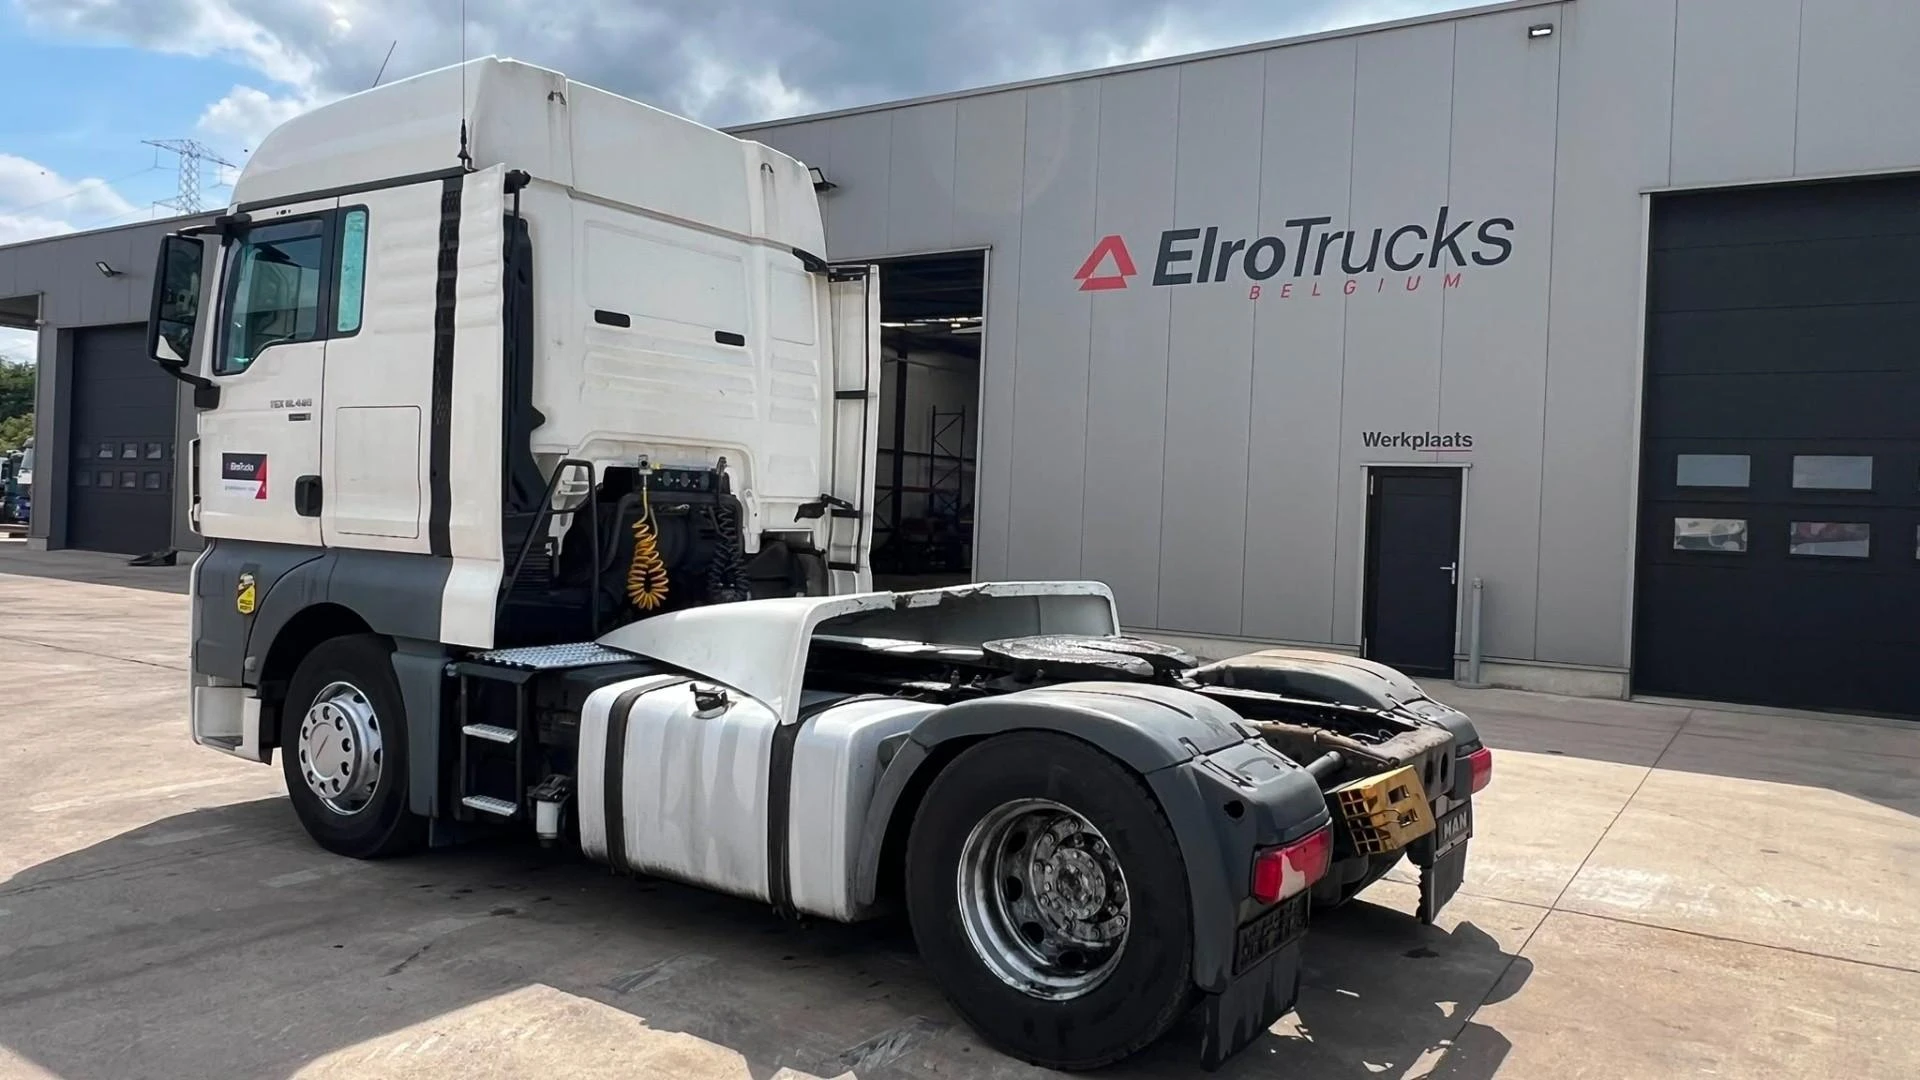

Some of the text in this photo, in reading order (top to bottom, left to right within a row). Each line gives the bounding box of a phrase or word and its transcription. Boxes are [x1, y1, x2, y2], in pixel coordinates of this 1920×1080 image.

[1152, 206, 1514, 286] ElroTrucks
[1249, 275, 1461, 300] BELGIUM
[1362, 431, 1473, 451] Werkplaats
[1444, 812, 1467, 840] MAN
